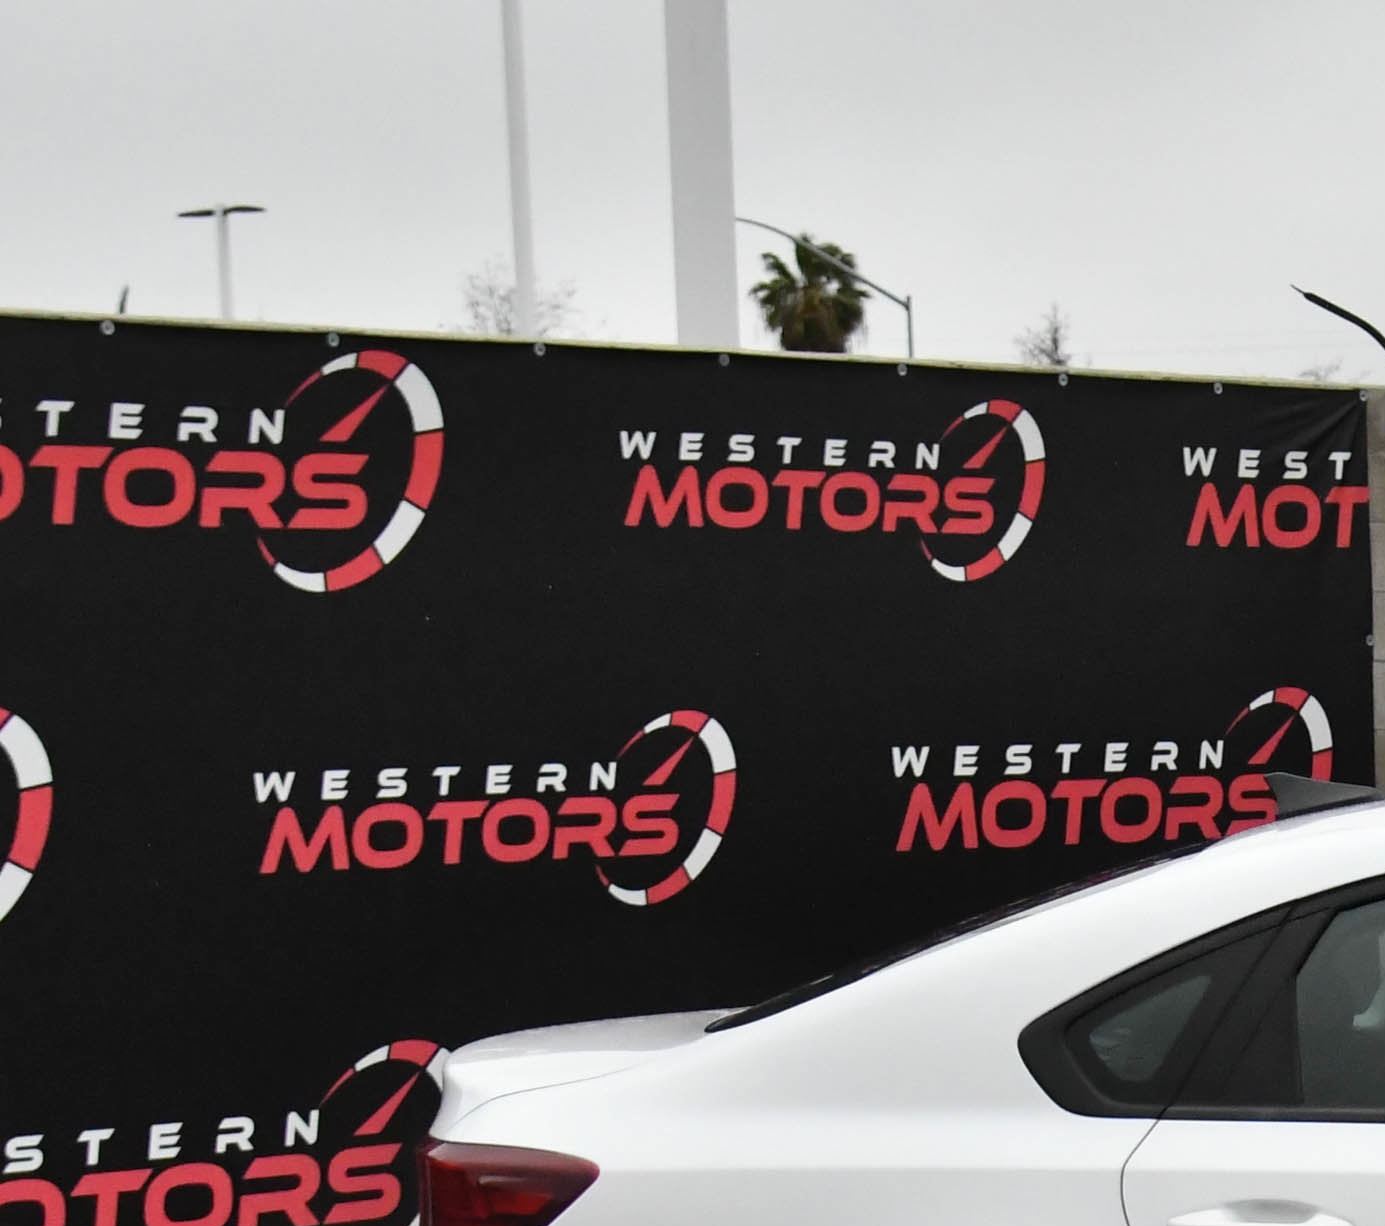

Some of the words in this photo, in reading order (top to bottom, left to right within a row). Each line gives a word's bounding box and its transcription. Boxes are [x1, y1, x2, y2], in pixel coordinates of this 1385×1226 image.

[0, 399, 286, 445] TERN
[619, 429, 941, 470] WESTERN
[0, 444, 370, 530] TORS
[1182, 446, 1353, 480] WEST
[624, 464, 996, 535] MOTORS
[1186, 482, 1371, 549] MOT
[253, 761, 617, 803] WESTERN
[891, 738, 1225, 778] WESTERN
[259, 792, 681, 874] MOTORS
[896, 773, 1278, 852] MOTORS
[2, 1108, 320, 1175] STERN
